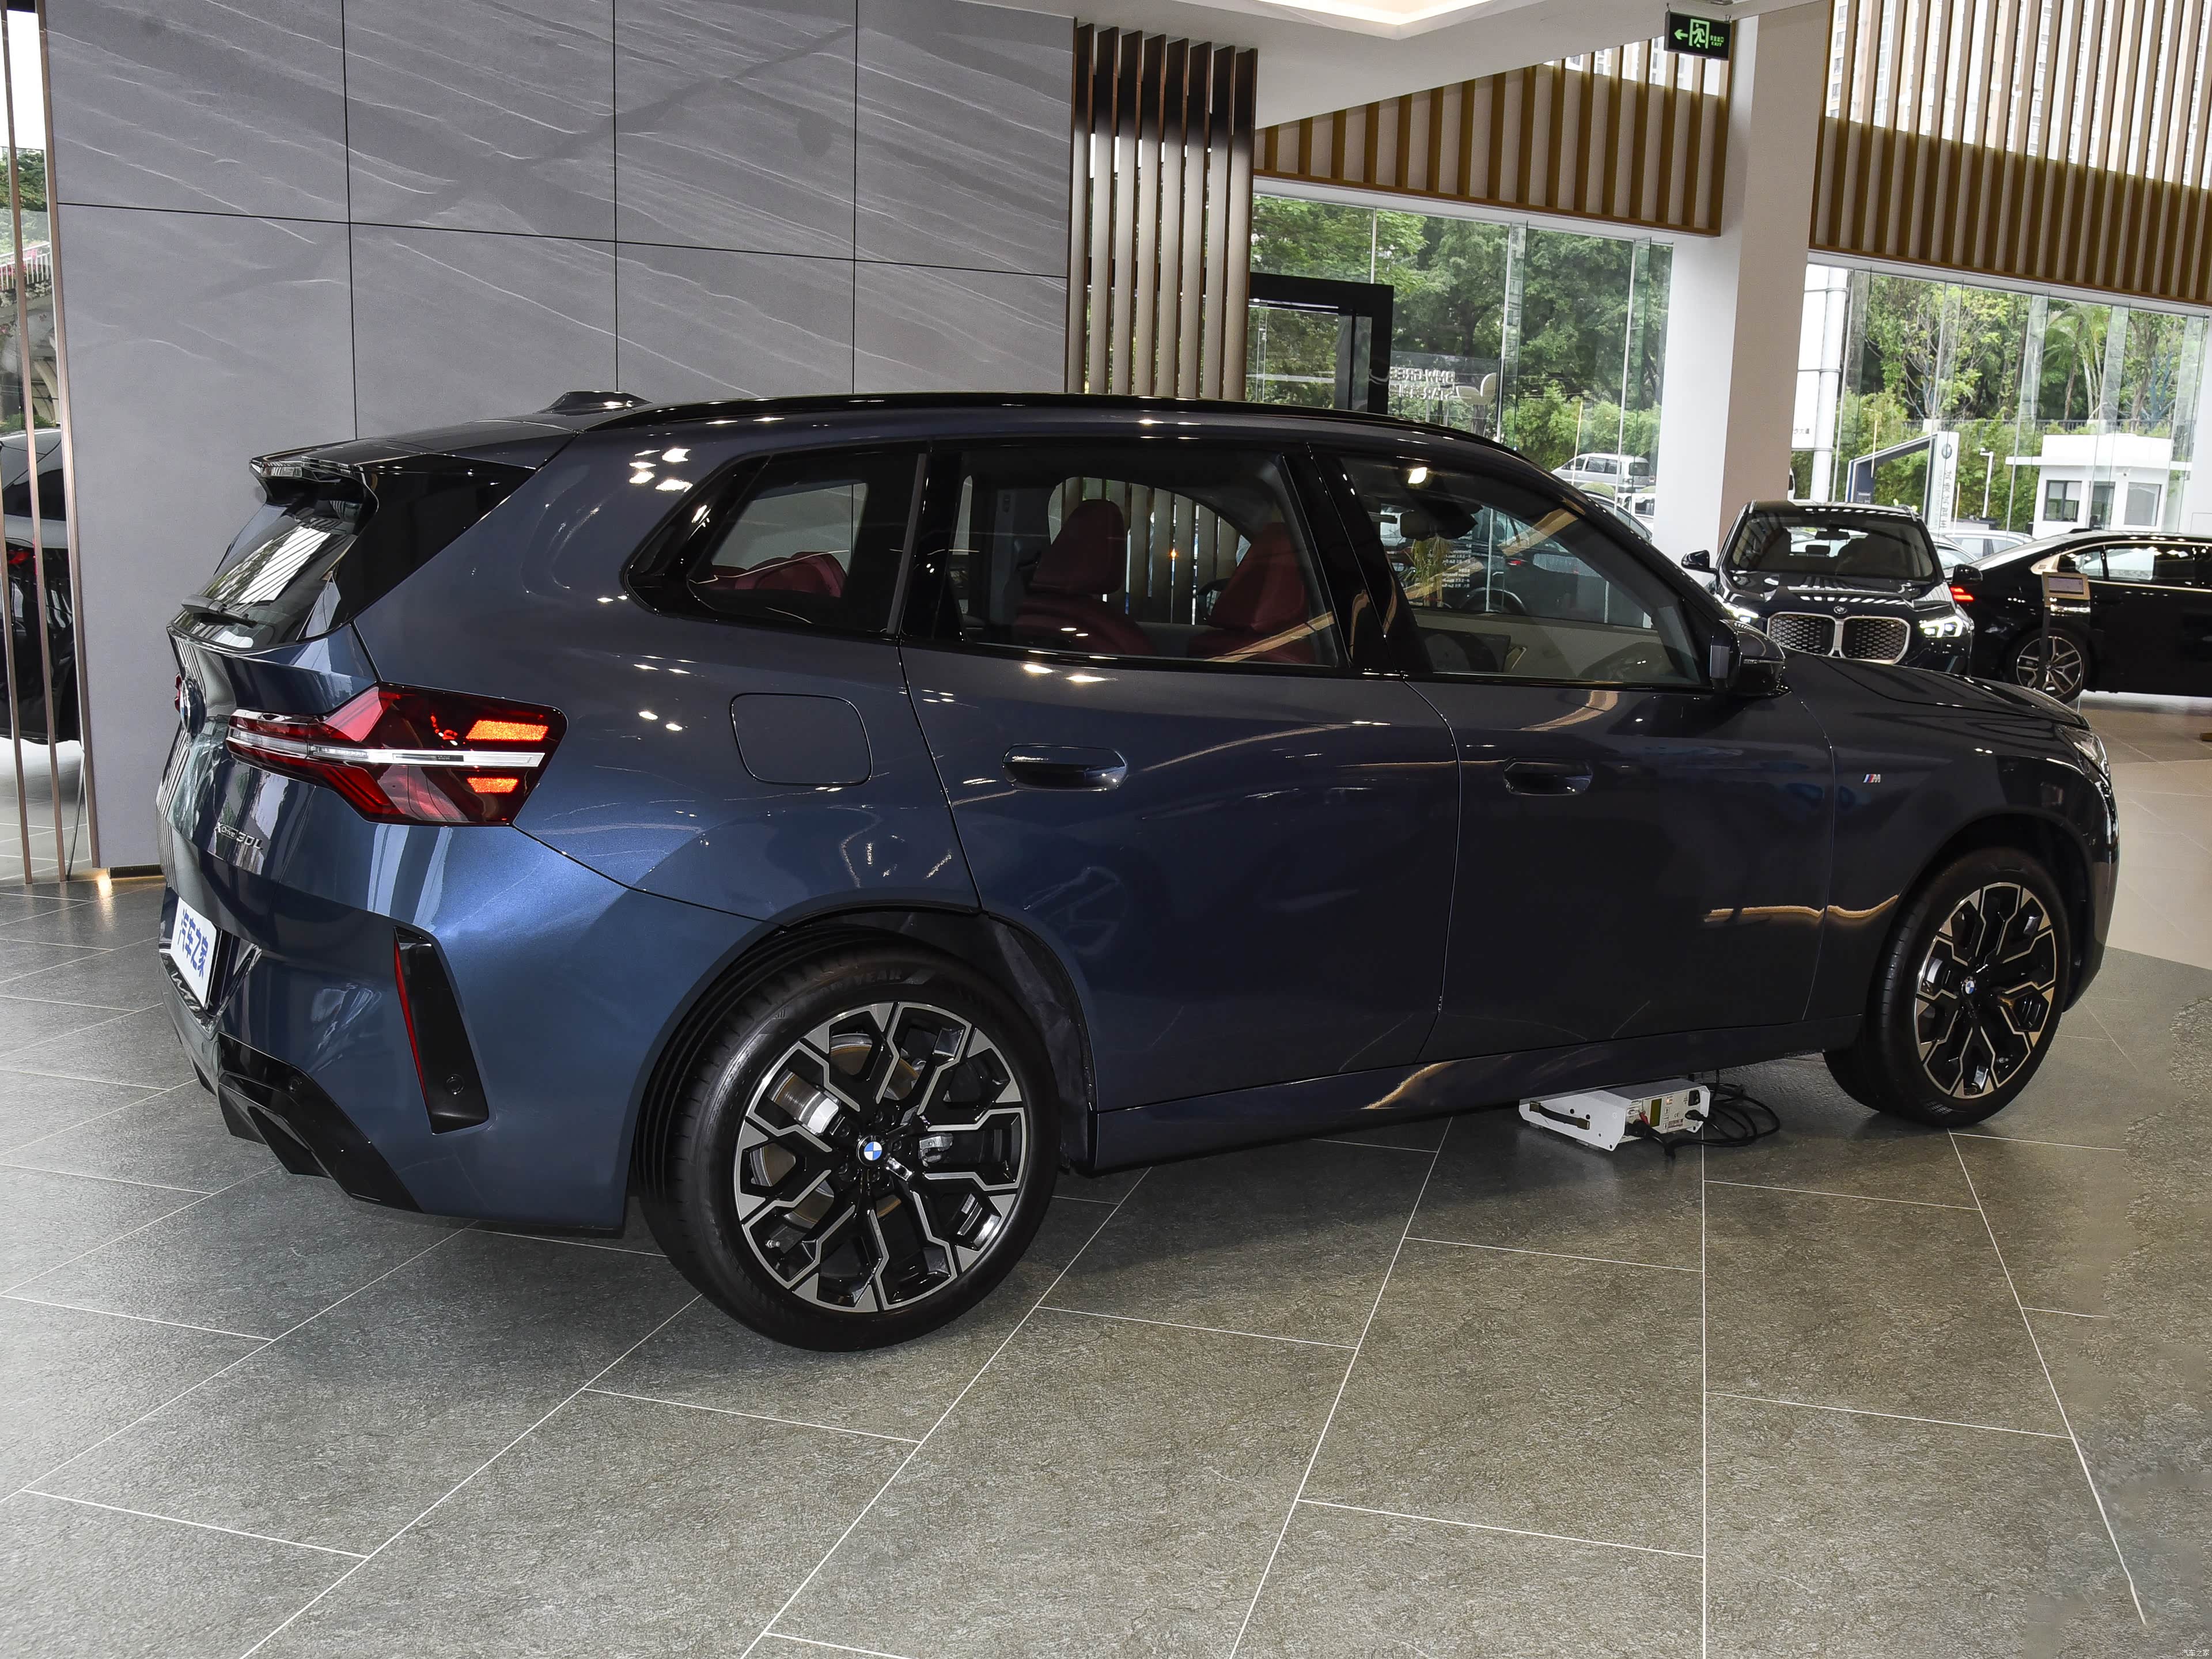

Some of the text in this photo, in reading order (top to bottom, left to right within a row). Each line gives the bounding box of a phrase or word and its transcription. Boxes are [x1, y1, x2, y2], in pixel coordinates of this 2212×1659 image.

[237, 831, 262, 849] 30L
[177, 908, 209, 979] 汽车之家
